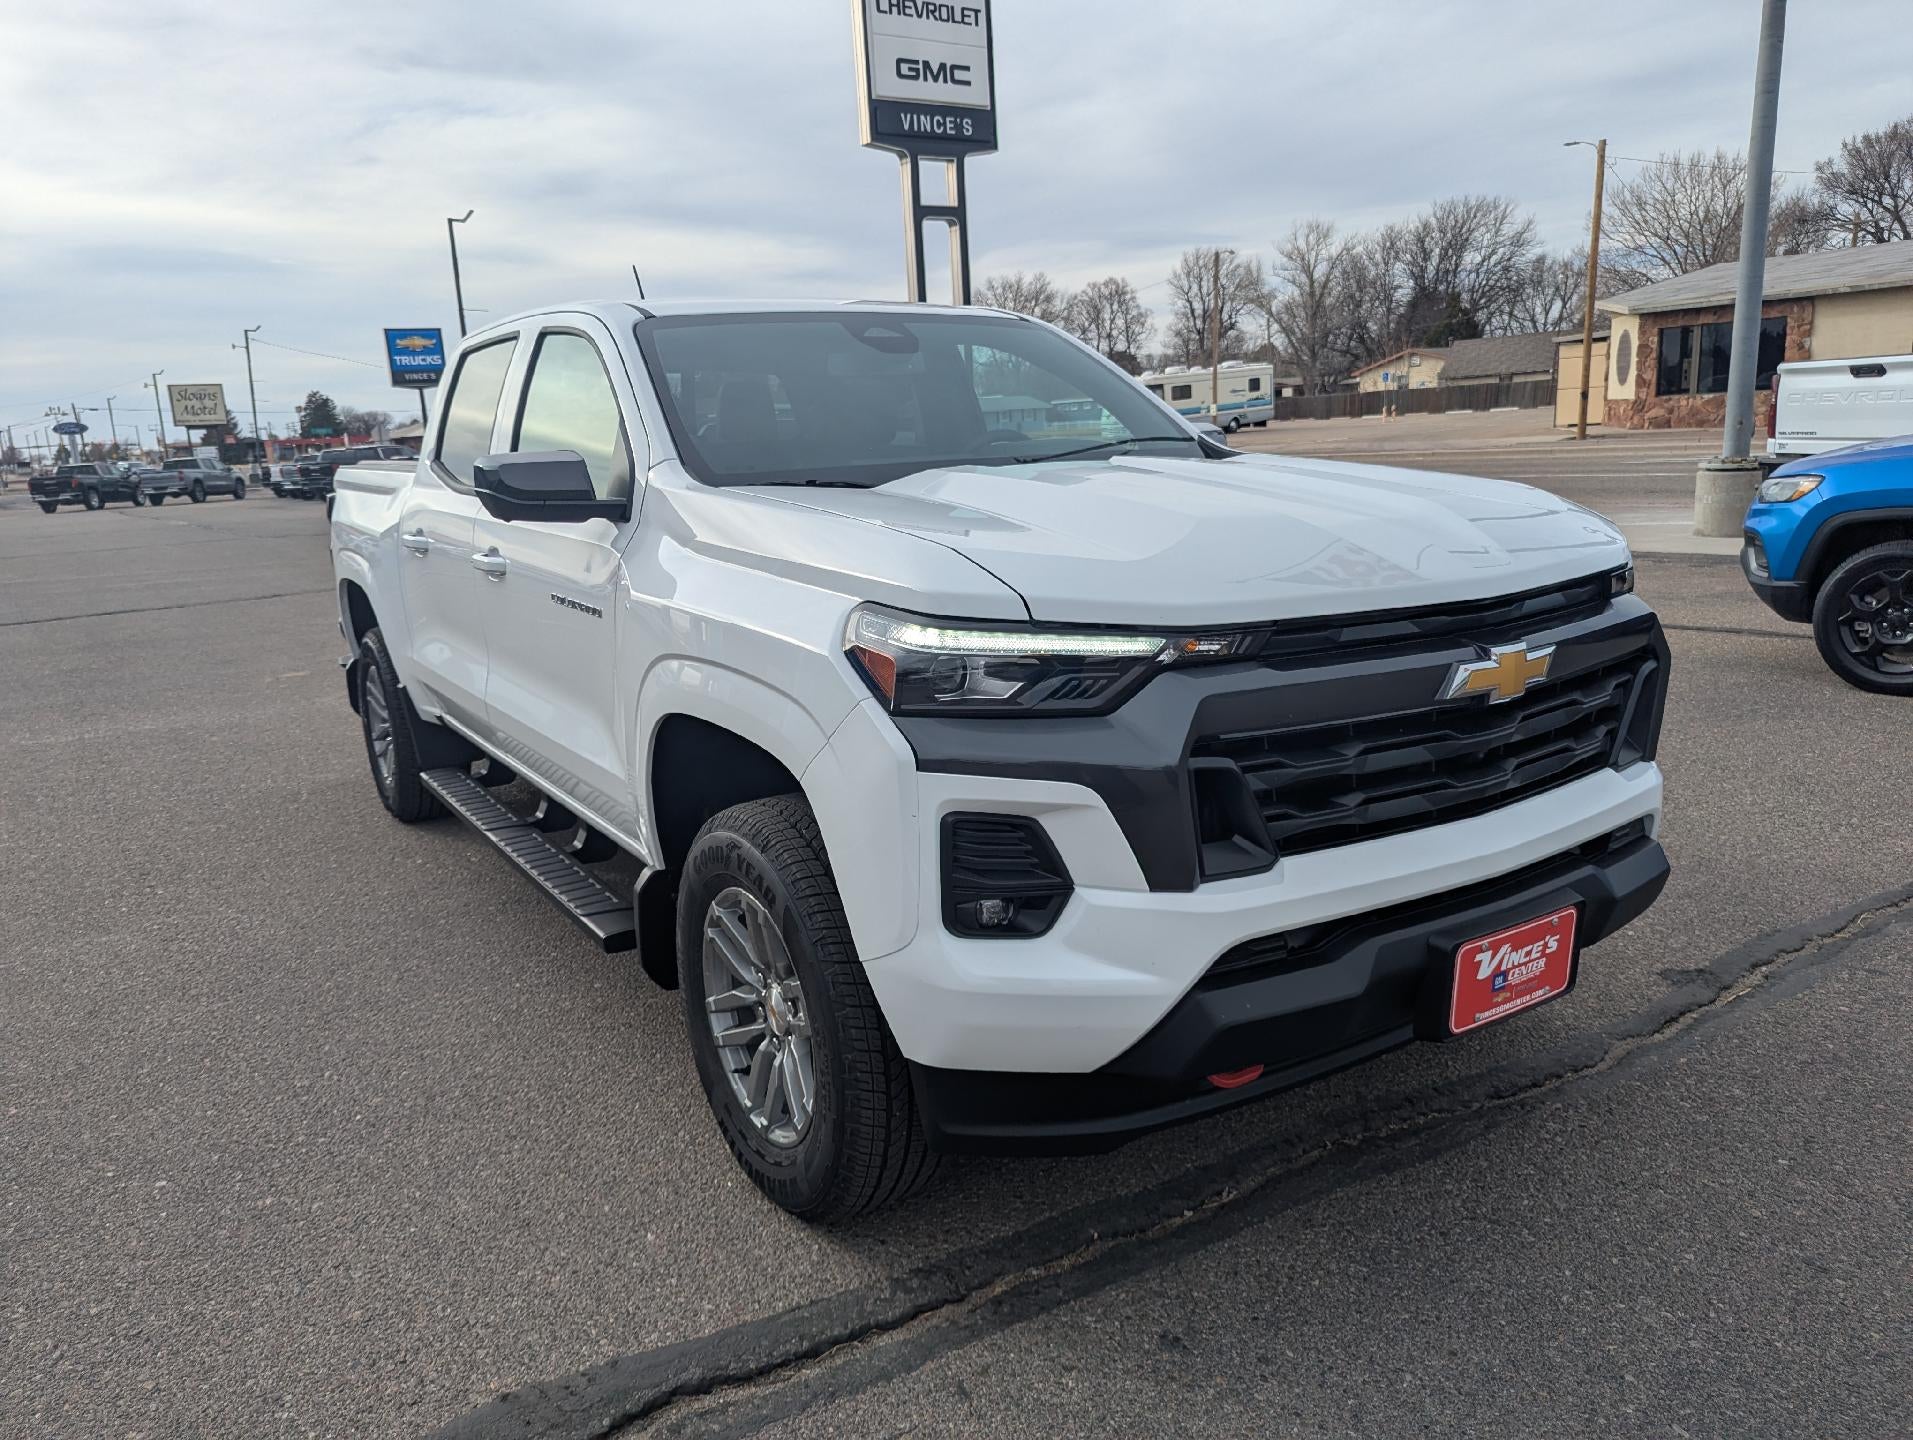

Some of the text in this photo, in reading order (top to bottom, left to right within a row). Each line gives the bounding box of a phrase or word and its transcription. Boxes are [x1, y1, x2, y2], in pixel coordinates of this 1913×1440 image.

[876, 0, 982, 27] CHEVROLET
[895, 57, 972, 87] GMC
[901, 113, 973, 136] VINCE'S
[393, 355, 442, 366] TRUCKS
[180, 401, 218, 416] Motel
[1508, 957, 1547, 981] CENTER
